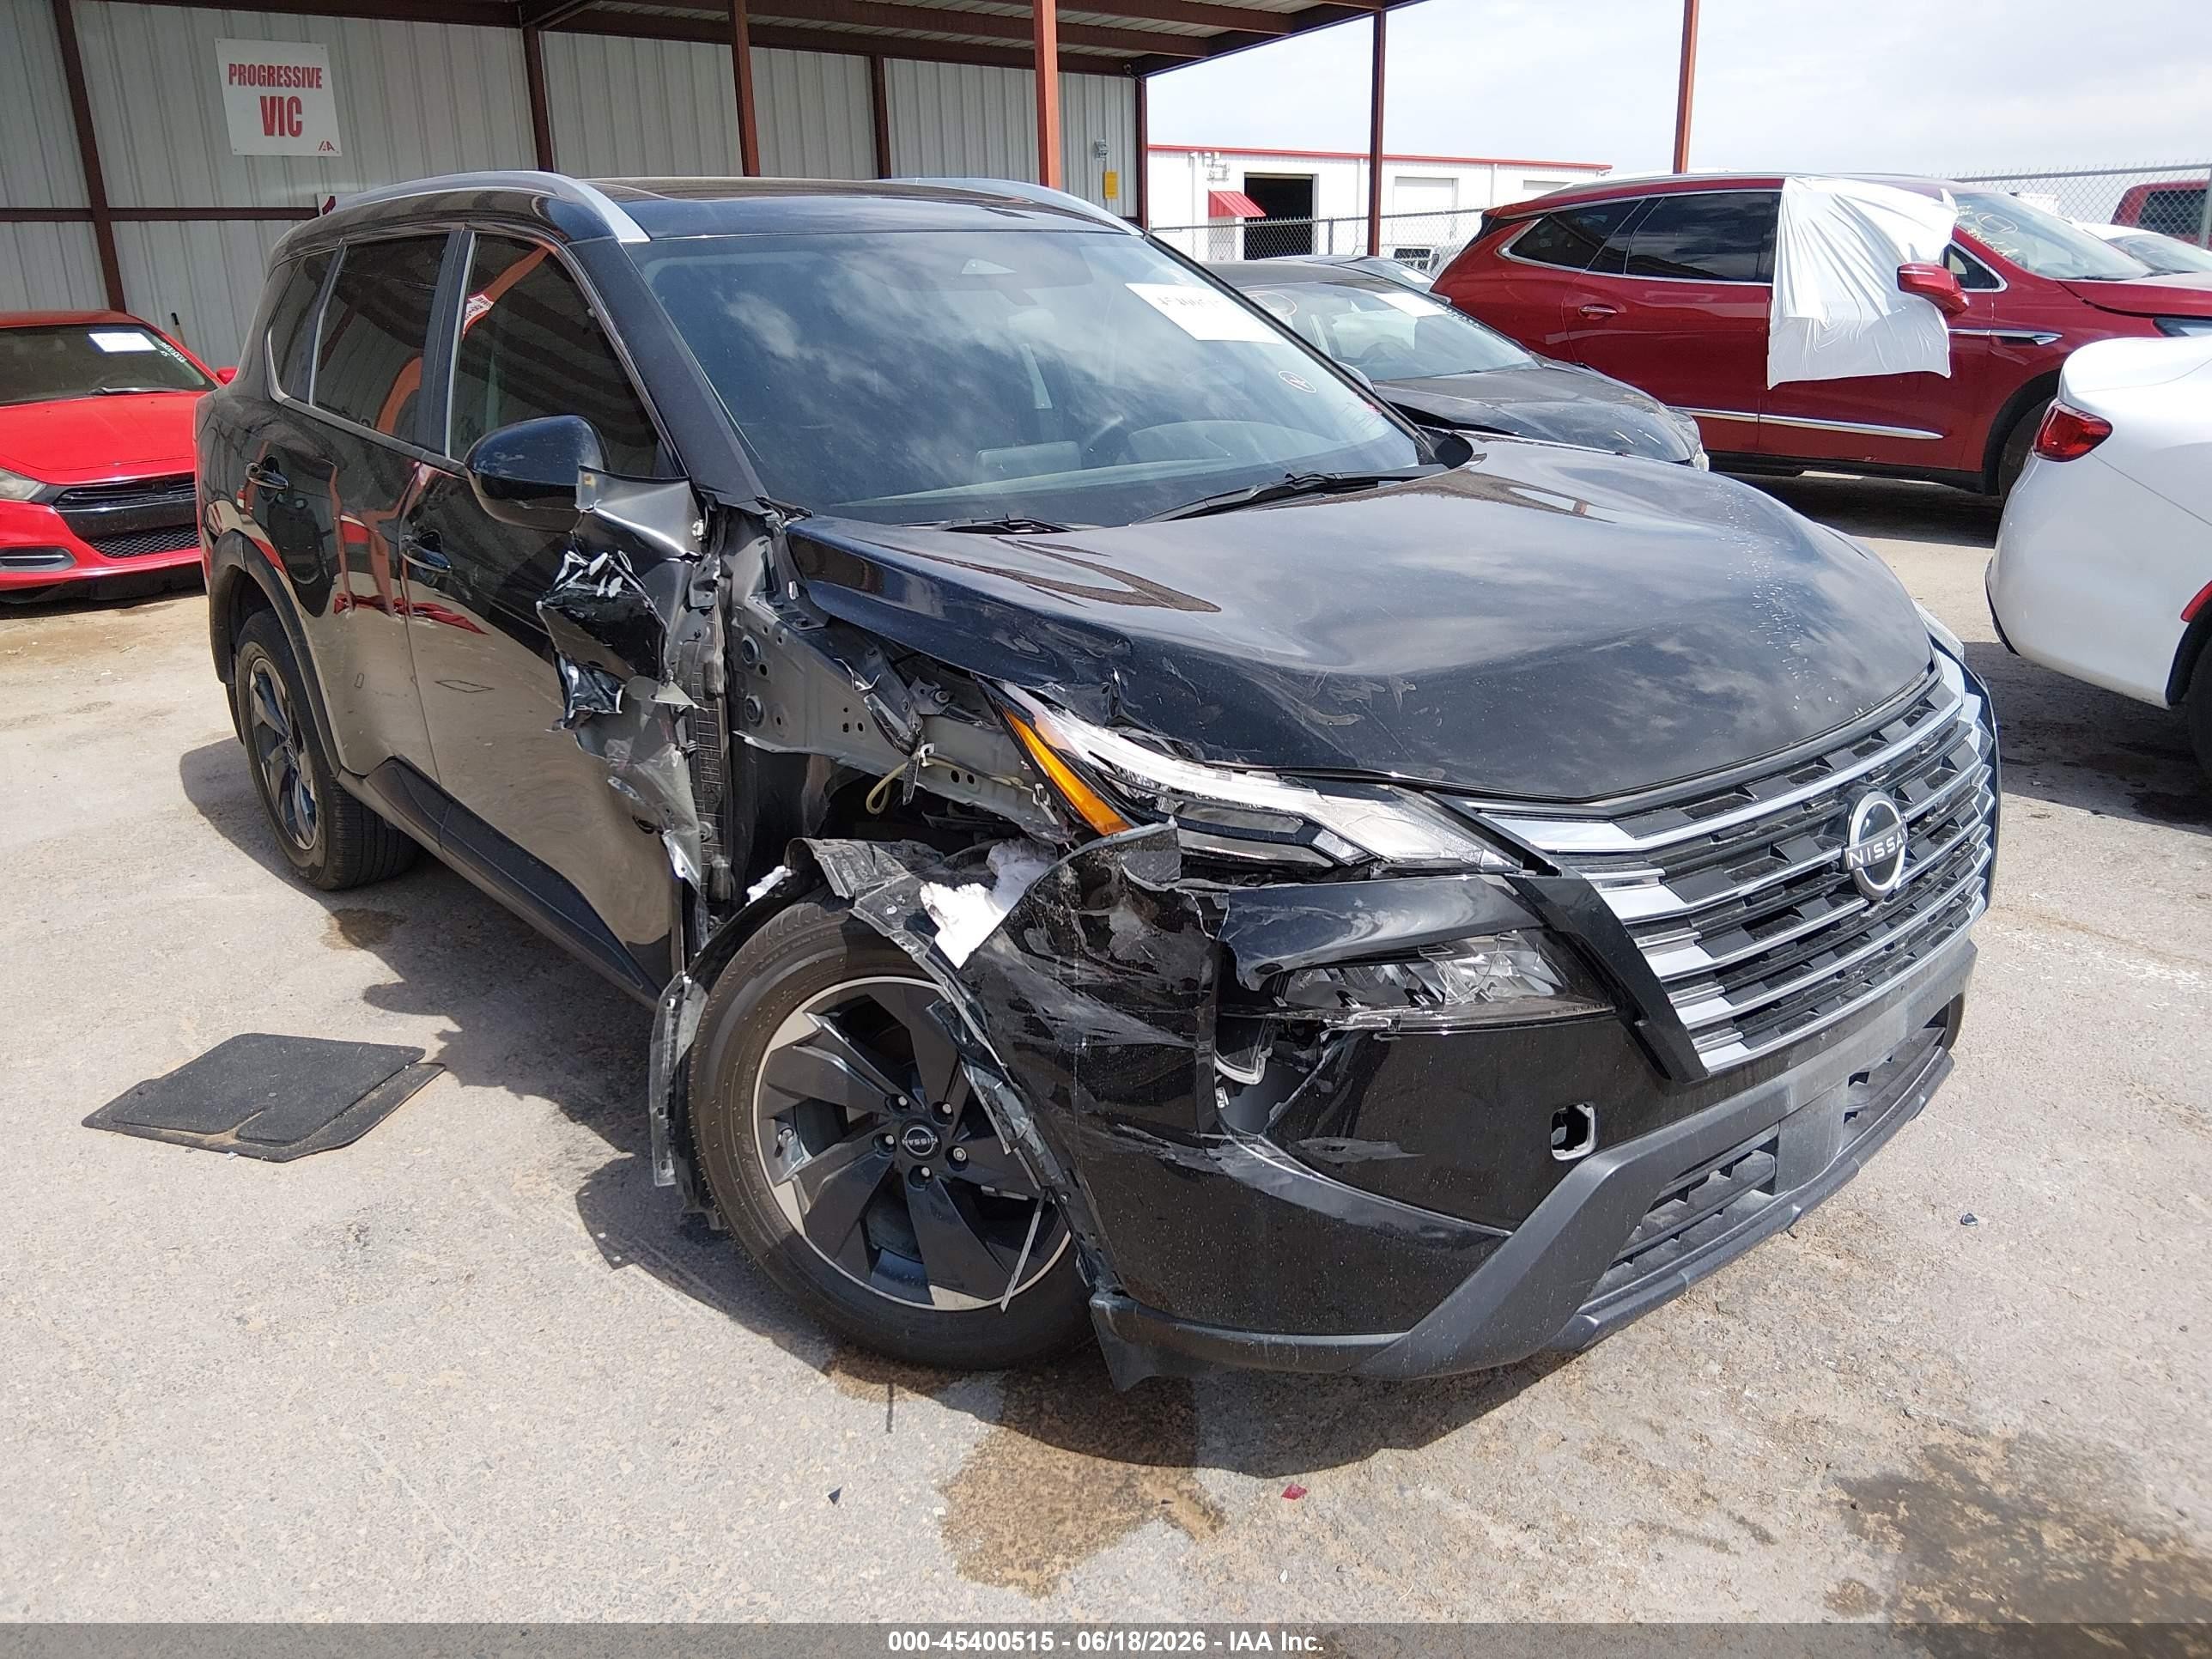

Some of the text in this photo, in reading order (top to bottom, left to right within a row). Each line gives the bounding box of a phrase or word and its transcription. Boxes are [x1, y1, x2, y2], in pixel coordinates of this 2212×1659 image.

[228, 64, 323, 89] PROGRESSIVE
[259, 96, 303, 137] VIC
[1848, 826, 1908, 867] NISSAN
[902, 1135, 939, 1146] NISSAN
